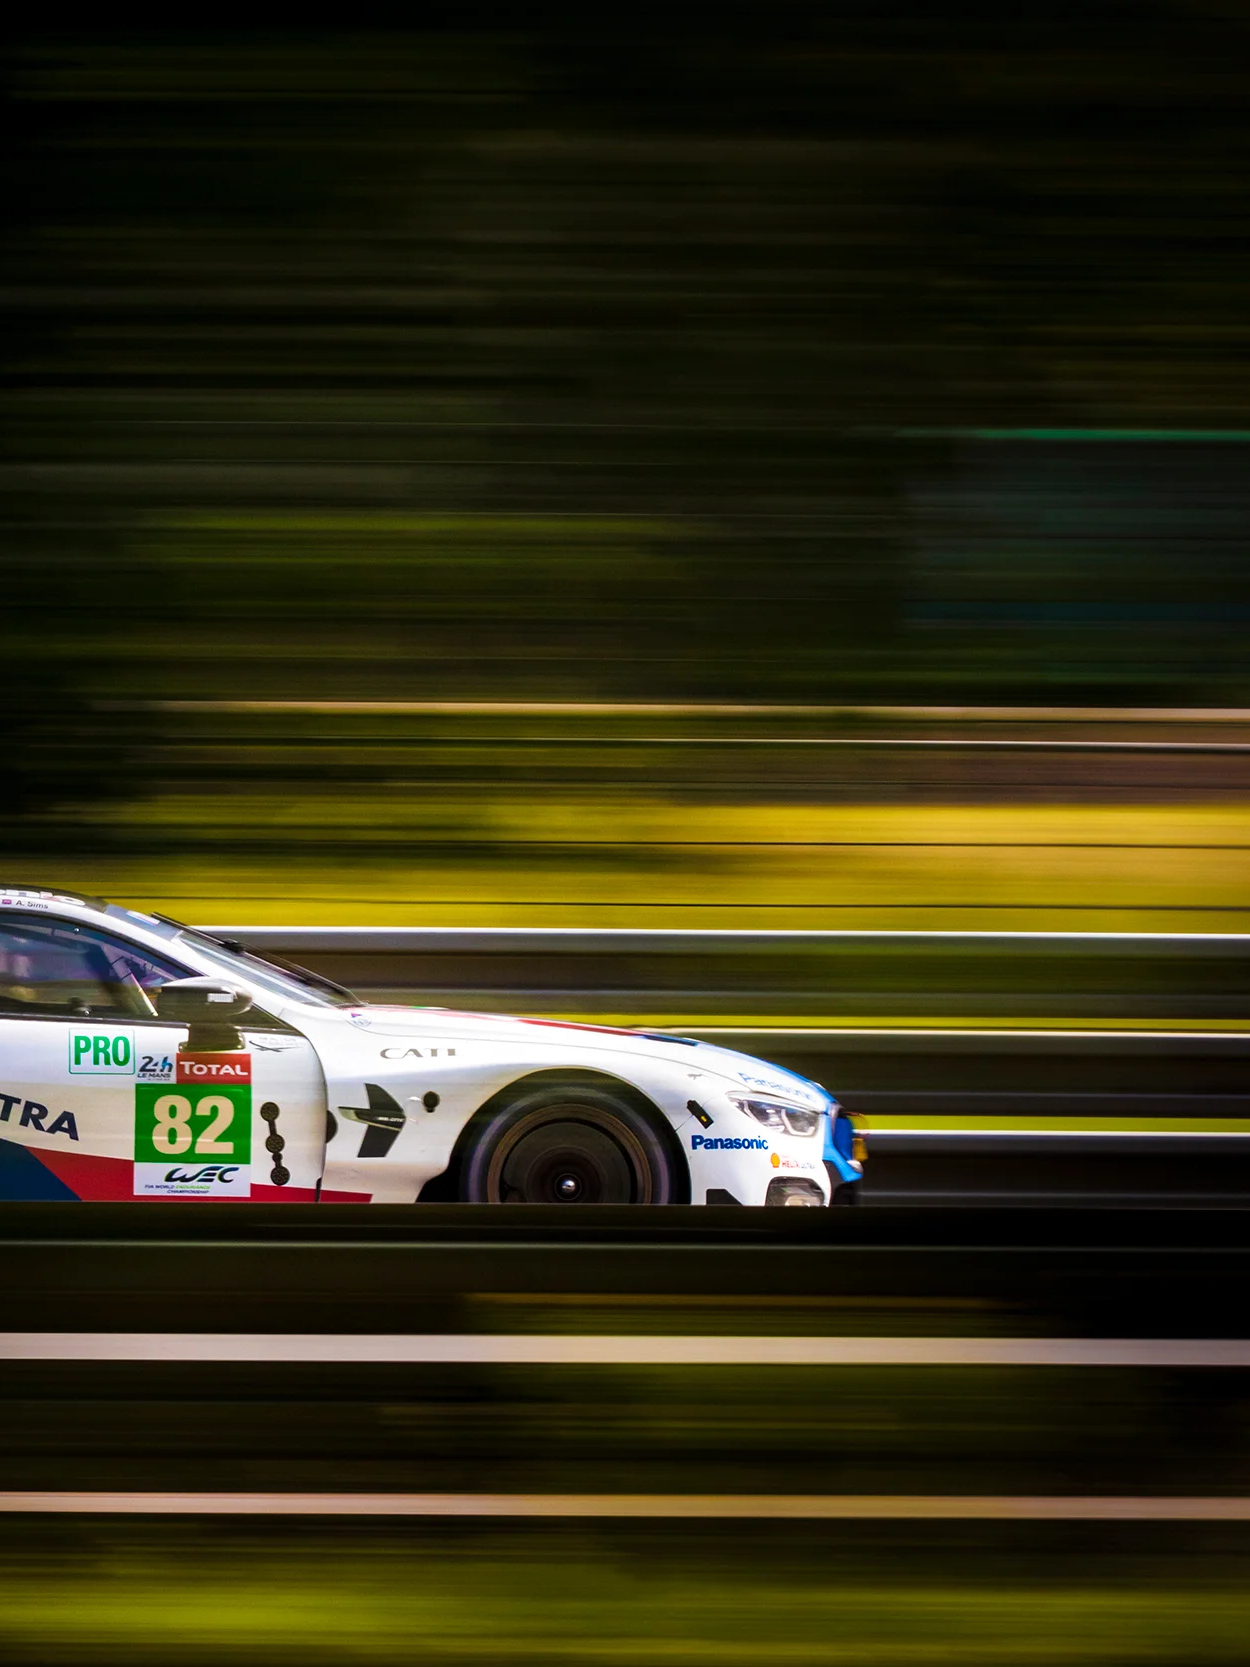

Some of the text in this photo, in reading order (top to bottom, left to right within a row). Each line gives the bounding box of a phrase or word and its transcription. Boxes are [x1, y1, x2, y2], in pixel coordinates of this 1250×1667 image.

[15, 899, 49, 909] A. Sims
[73, 1035, 131, 1067] PRO
[179, 1061, 249, 1076] TOTAL
[152, 1094, 235, 1155] 82
[691, 1135, 769, 1150] Panasonic
[164, 1165, 240, 1184] WEC
